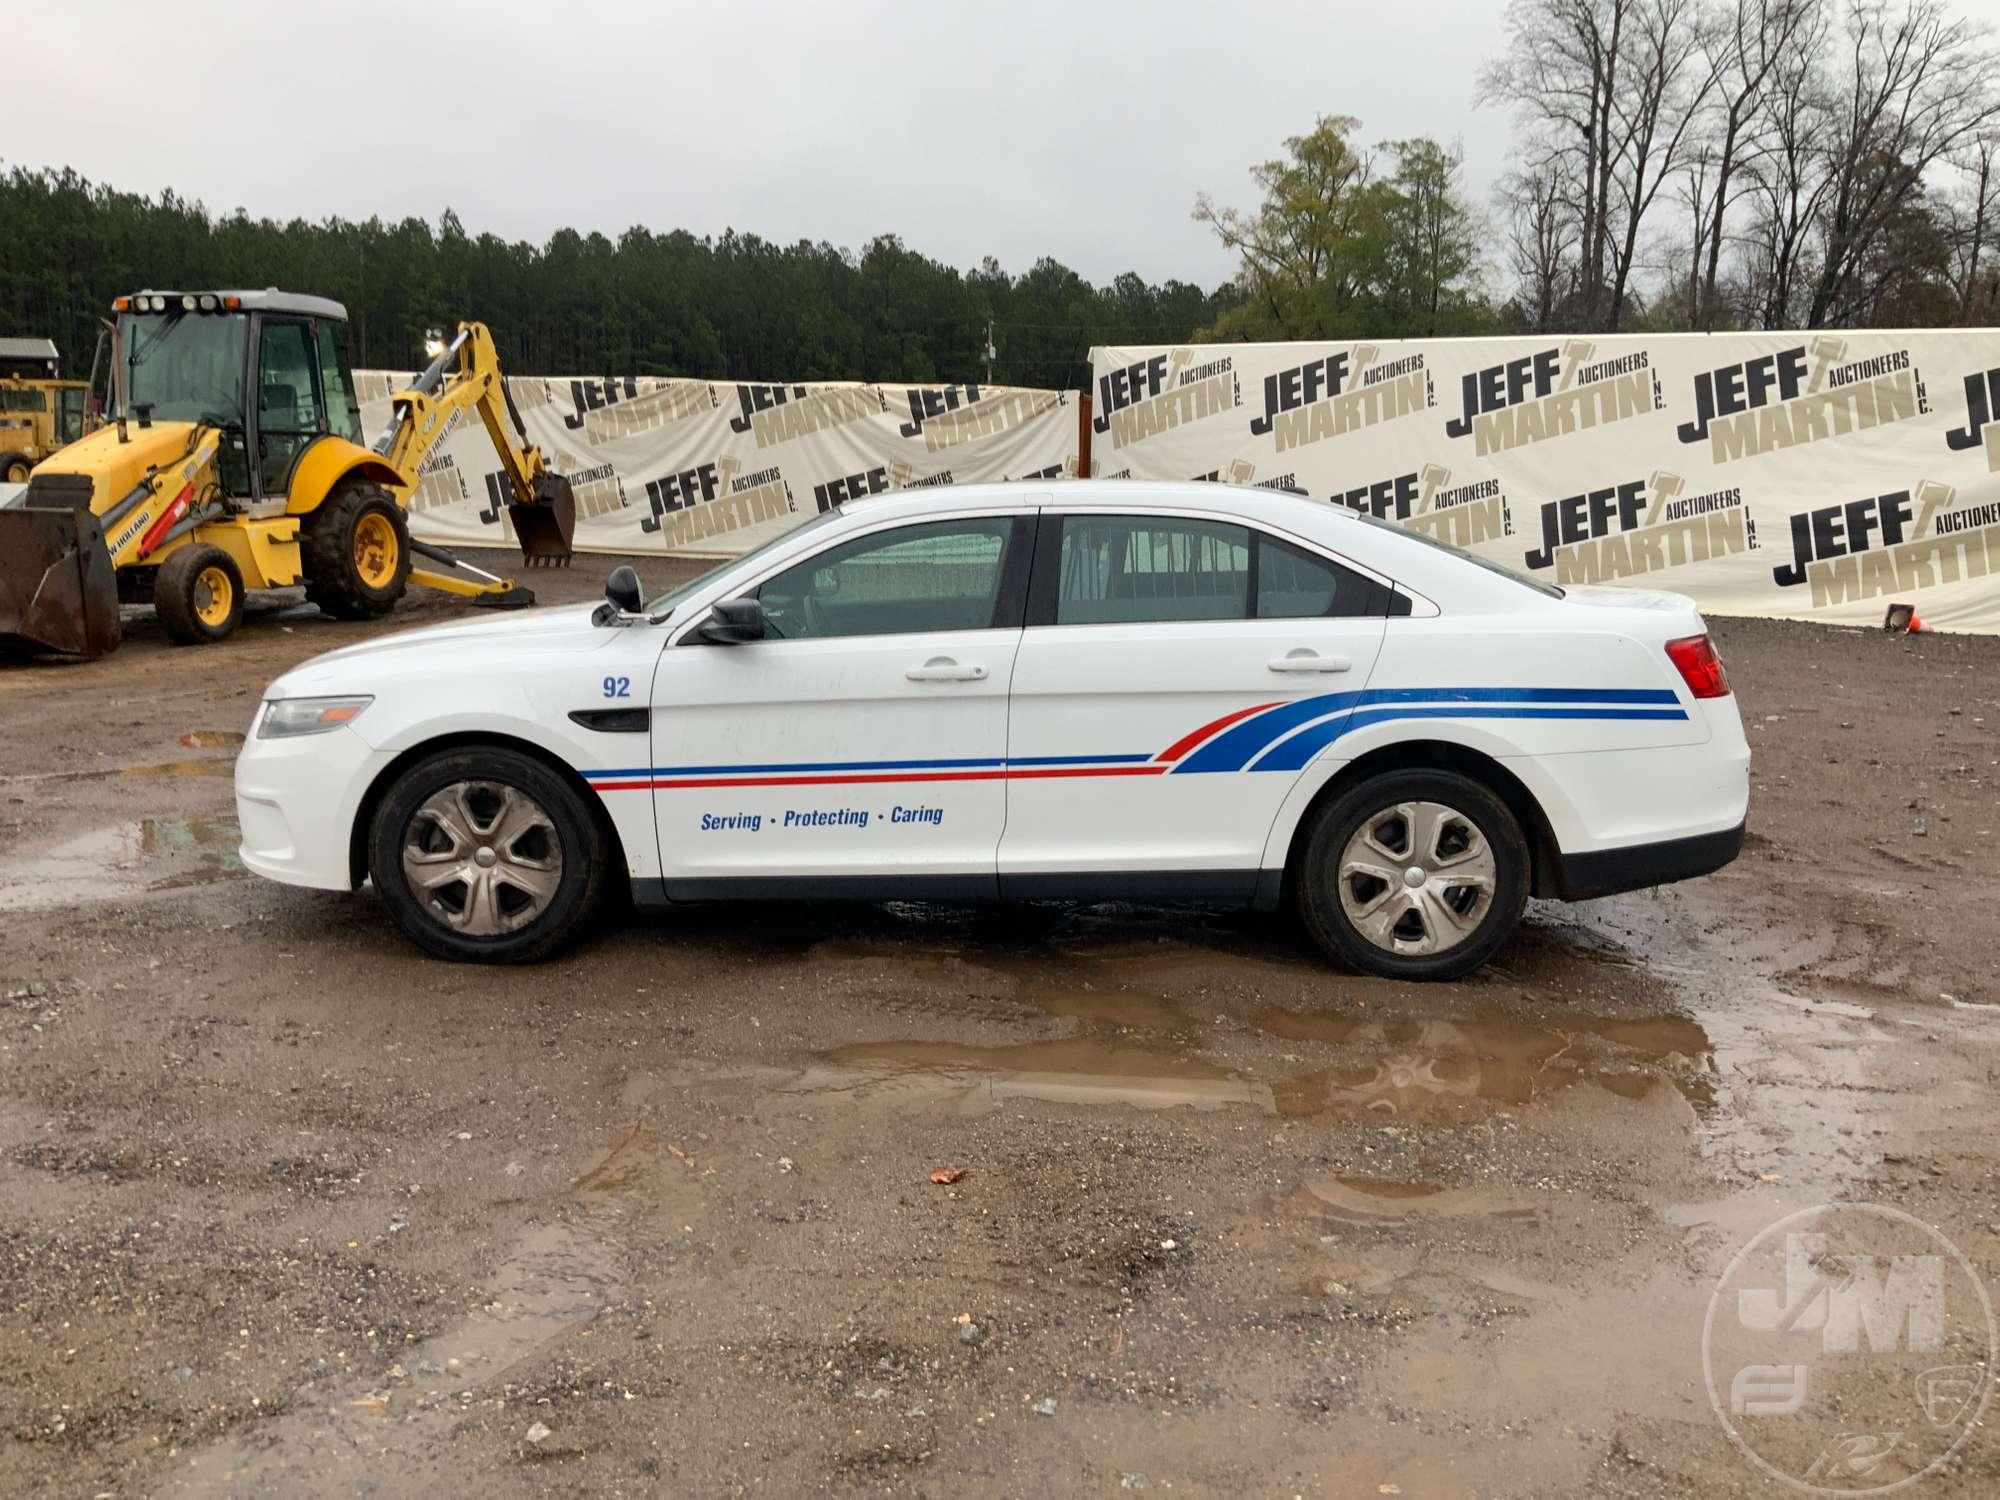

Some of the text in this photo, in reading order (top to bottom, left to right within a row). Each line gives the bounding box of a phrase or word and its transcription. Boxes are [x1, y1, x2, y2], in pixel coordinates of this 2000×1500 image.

[1093, 354, 1167, 434] JEFF
[1179, 357, 1232, 387] AUCTIONEERS
[1250, 352, 1349, 436] JEFF
[1363, 354, 1424, 386] AUCTIONEERS
[1446, 348, 1561, 438] JEFF
[1577, 351, 1649, 386] AUCTIONEERS
[1677, 346, 1808, 444] JEFF
[1829, 350, 1910, 388] AUCTIONEERS
[1109, 373, 1233, 450] MARTIN
[1272, 370, 1425, 453] MARTIN
[1471, 369, 1652, 457] MARTIN
[1707, 371, 1916, 464] MARTIN
[641, 462, 719, 533] JEFF
[661, 481, 789, 548] MARTIN
[731, 467, 781, 493] AUCTIONEERS
[1435, 479, 1499, 510] AUCTIONEERS
[1666, 488, 1741, 521] AUCTIONEERS
[1525, 480, 1647, 570] JEFF
[1553, 508, 1745, 584] MARTIN
[1773, 489, 1913, 587] JEFF
[603, 677, 630, 698] 92
[702, 806, 943, 831] Serving Protecting Caring
